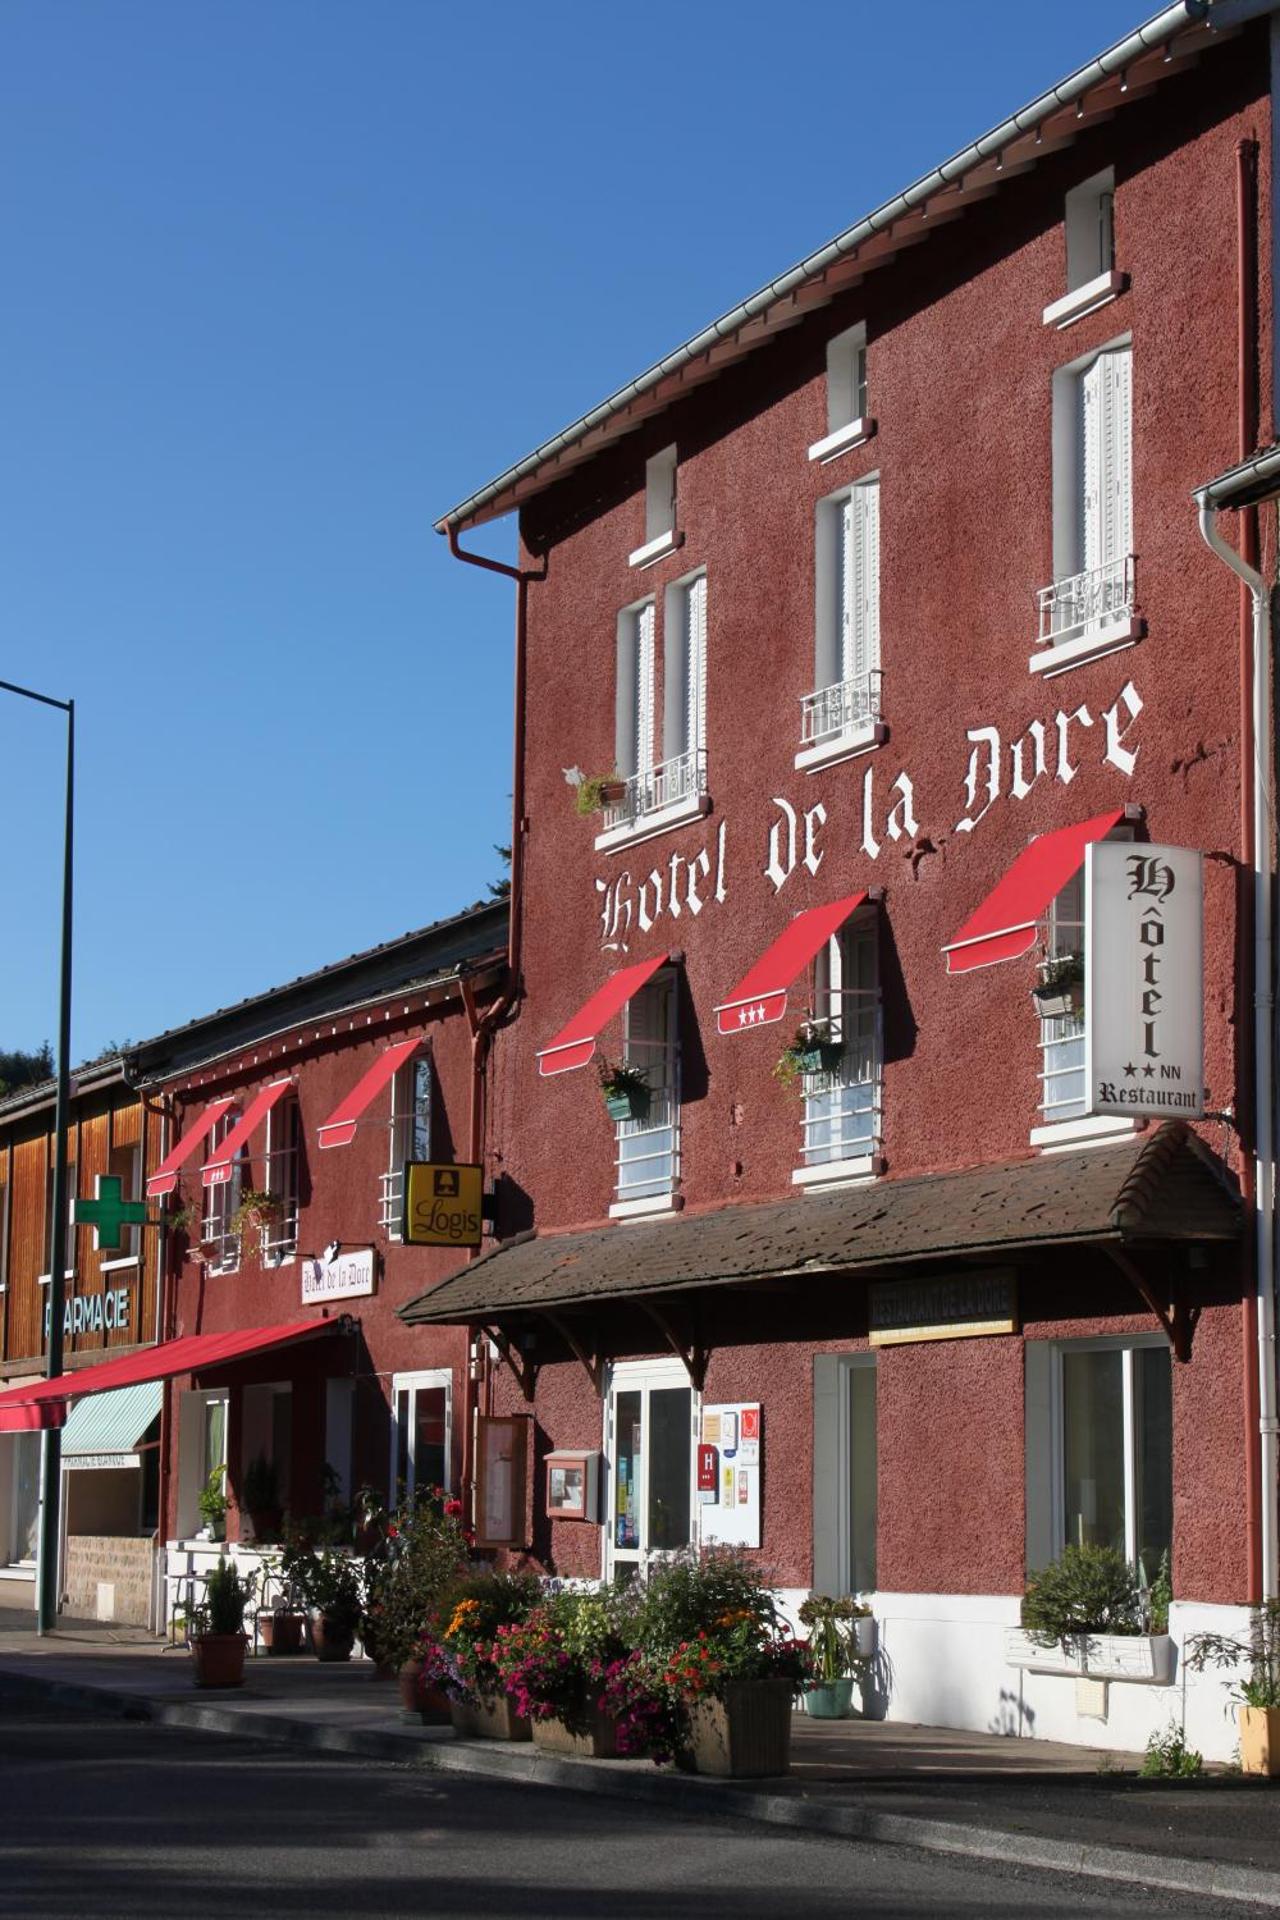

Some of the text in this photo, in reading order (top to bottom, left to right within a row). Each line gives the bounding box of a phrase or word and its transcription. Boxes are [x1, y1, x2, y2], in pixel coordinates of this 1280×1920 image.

[858, 765, 920, 861] la
[954, 680, 1144, 834] Dore
[1126, 855, 1176, 1058] Hôtel
[1160, 1064, 1181, 1080] NN
[1098, 1082, 1197, 1108] Restaurant
[414, 1200, 478, 1239] Logis
[45, 1288, 128, 1337] PARMACIE
[704, 1453, 713, 1470] H
